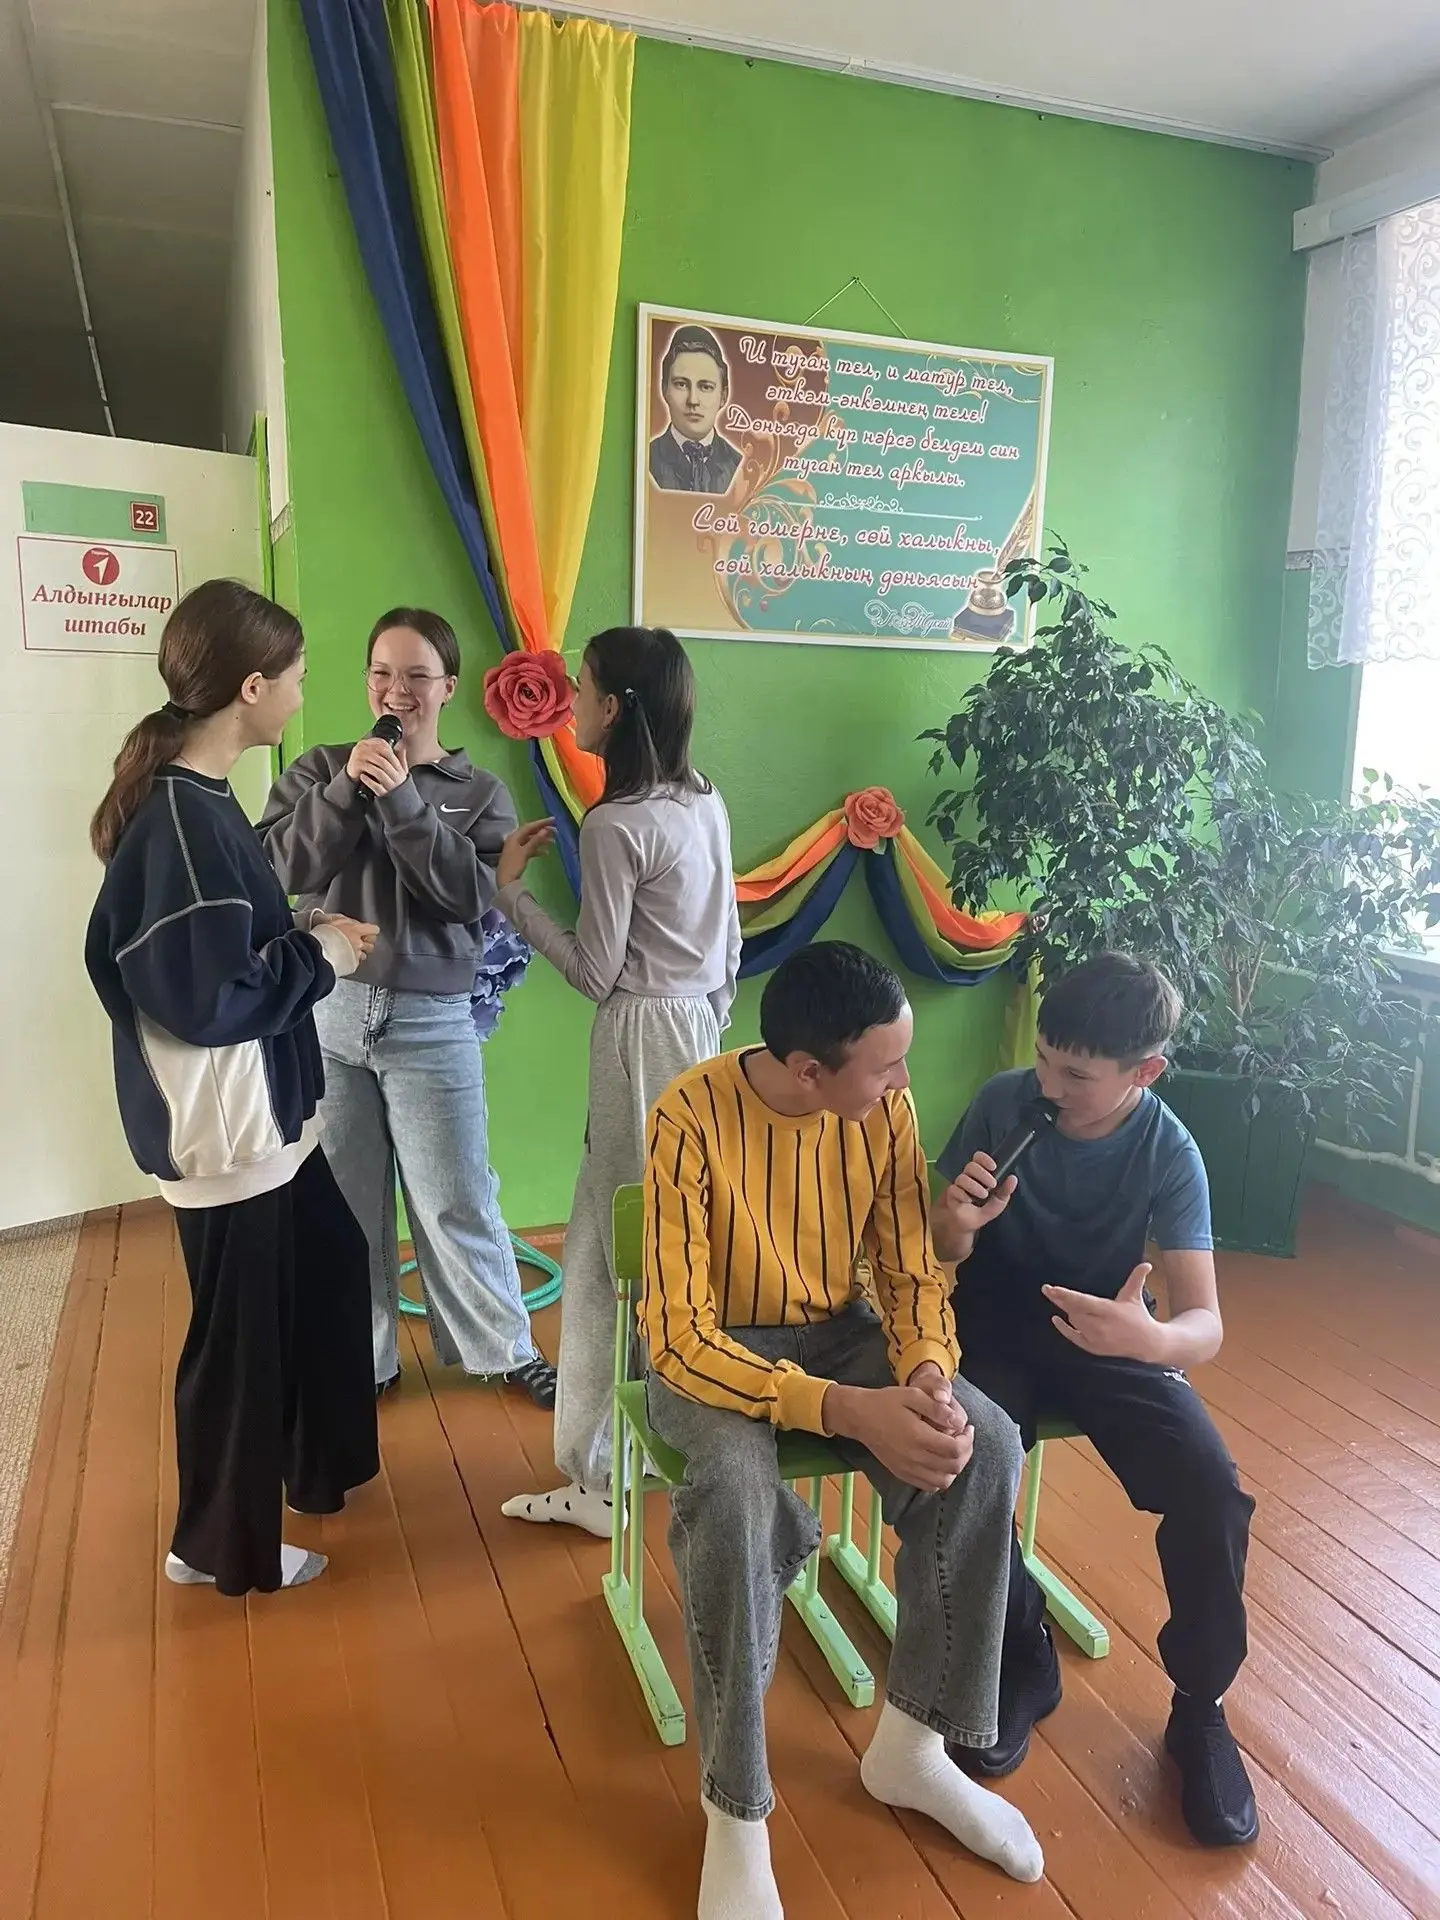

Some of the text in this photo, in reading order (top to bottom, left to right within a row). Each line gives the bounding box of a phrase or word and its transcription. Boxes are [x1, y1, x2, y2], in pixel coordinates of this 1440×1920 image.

[740, 337, 1013, 395] И туган тел, и матур тел,
[766, 378, 987, 422] әткәм-әнкәмнең теле!
[726, 405, 1019, 461] Дөньяда күп нәрсә белдем син
[784, 457, 965, 488] туган тел аркылы.
[136, 510, 154, 526] 22
[692, 504, 739, 535] Сөй
[856, 525, 891, 544] сөй
[899, 523, 1000, 556] халыкны,
[715, 553, 979, 595] сөй халыкның дөньясын
[32, 584, 172, 613] Алдынгылар
[64, 617, 146, 635] штабы
